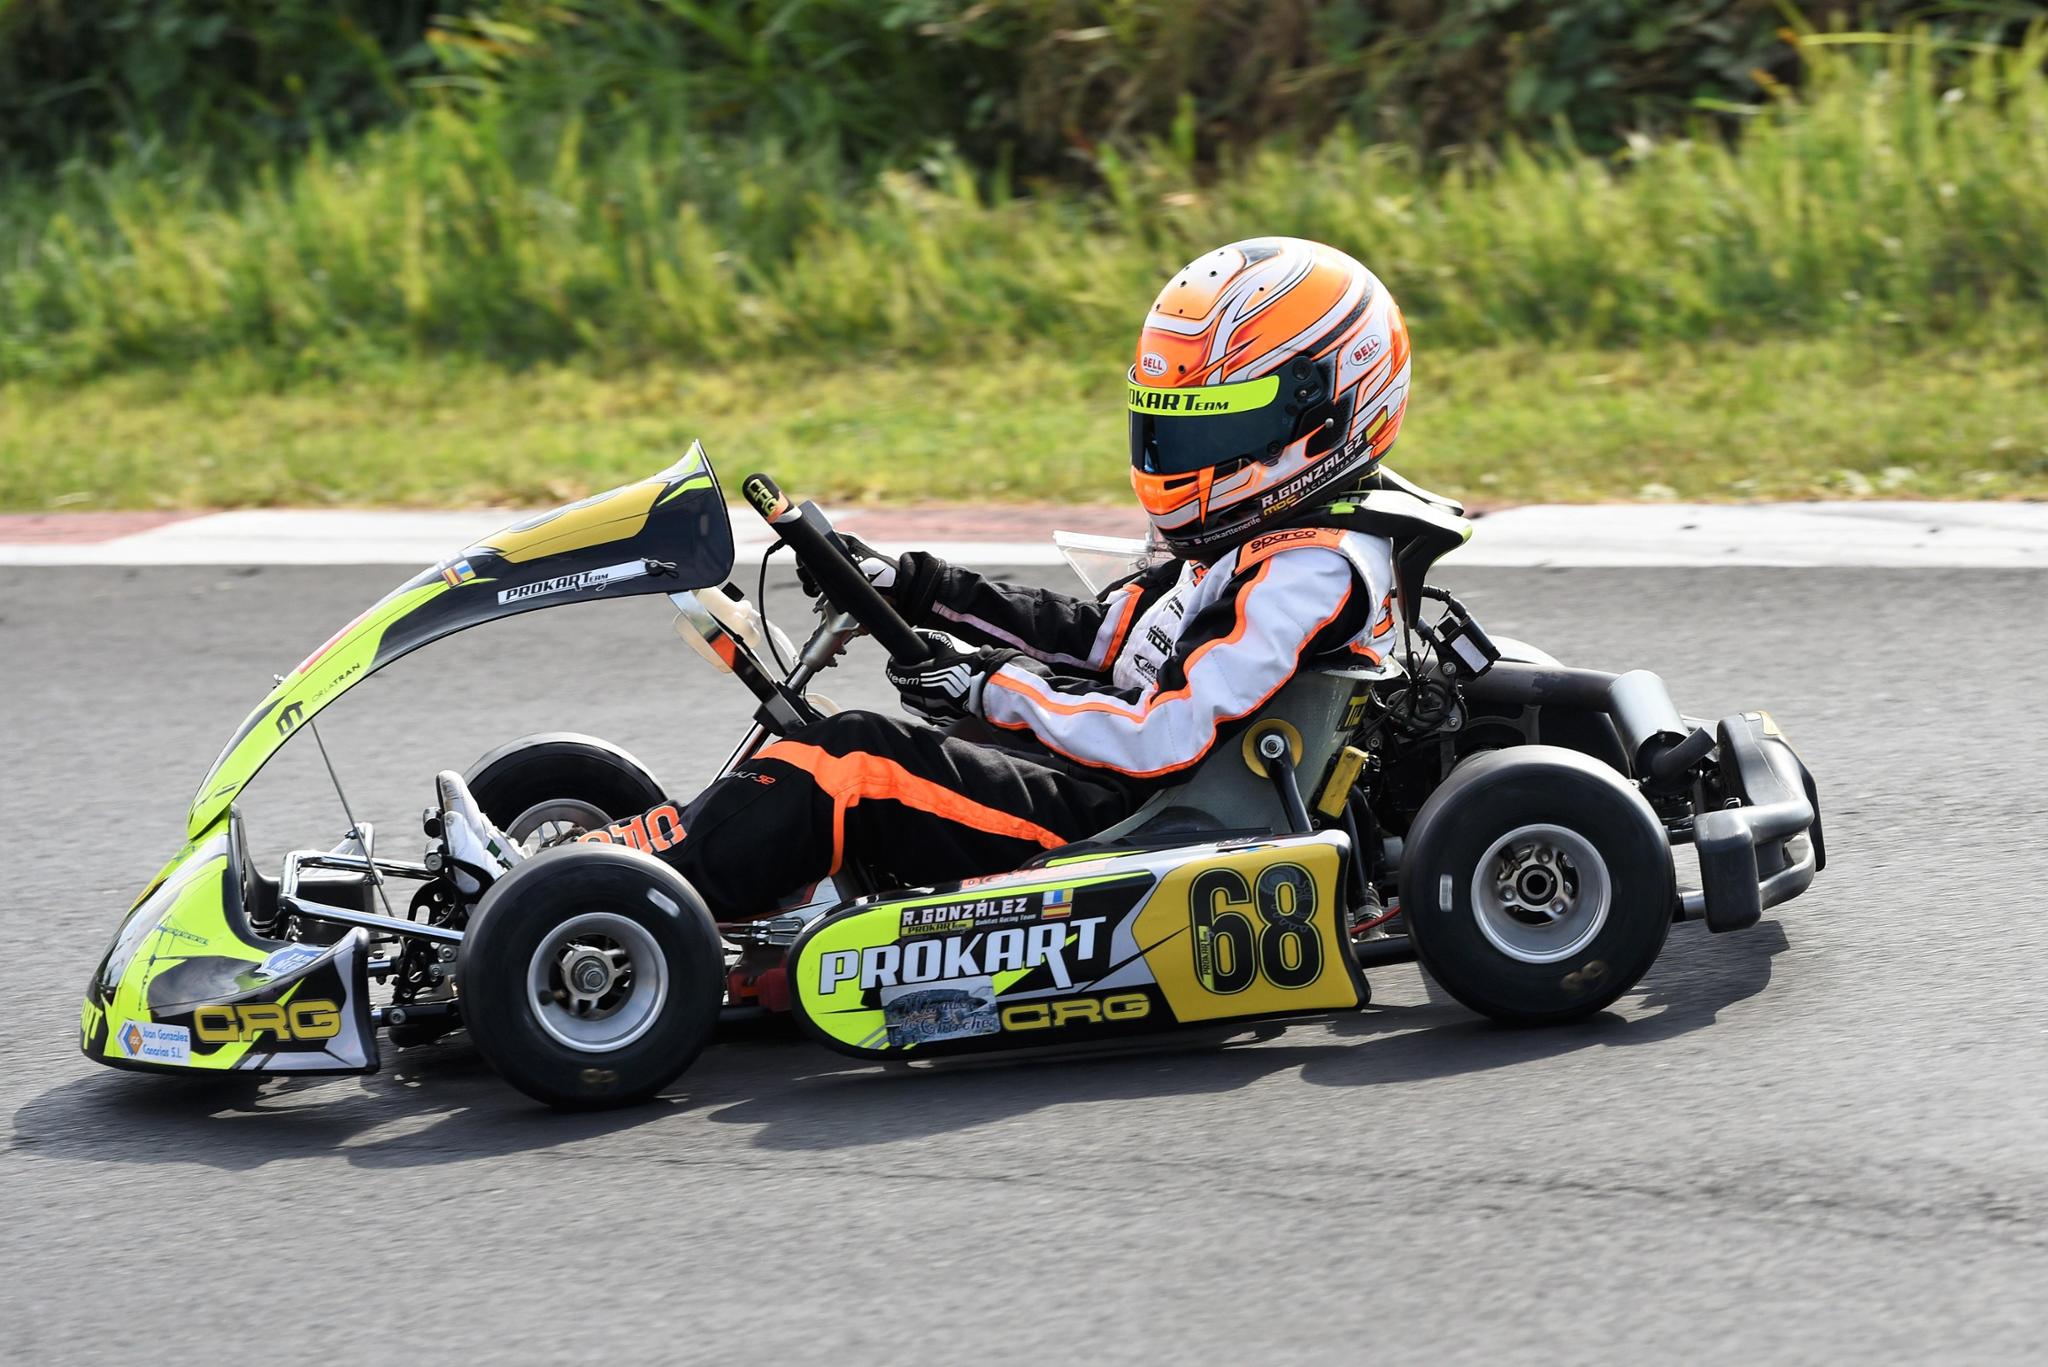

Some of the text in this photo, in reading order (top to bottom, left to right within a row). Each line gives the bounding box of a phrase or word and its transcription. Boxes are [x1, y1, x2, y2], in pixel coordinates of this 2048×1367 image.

[1143, 357, 1162, 370] BELL
[1353, 340, 1379, 360] BELL
[748, 478, 778, 516] CRG
[1251, 530, 1317, 553] sparco
[902, 897, 1028, 926] R.GONZÁLEZ
[1189, 861, 1324, 996] 68
[819, 916, 1107, 995] PROKART
[193, 998, 343, 1043] CRG
[1001, 993, 1150, 1031] CRG
[142, 1026, 157, 1039] Juan
